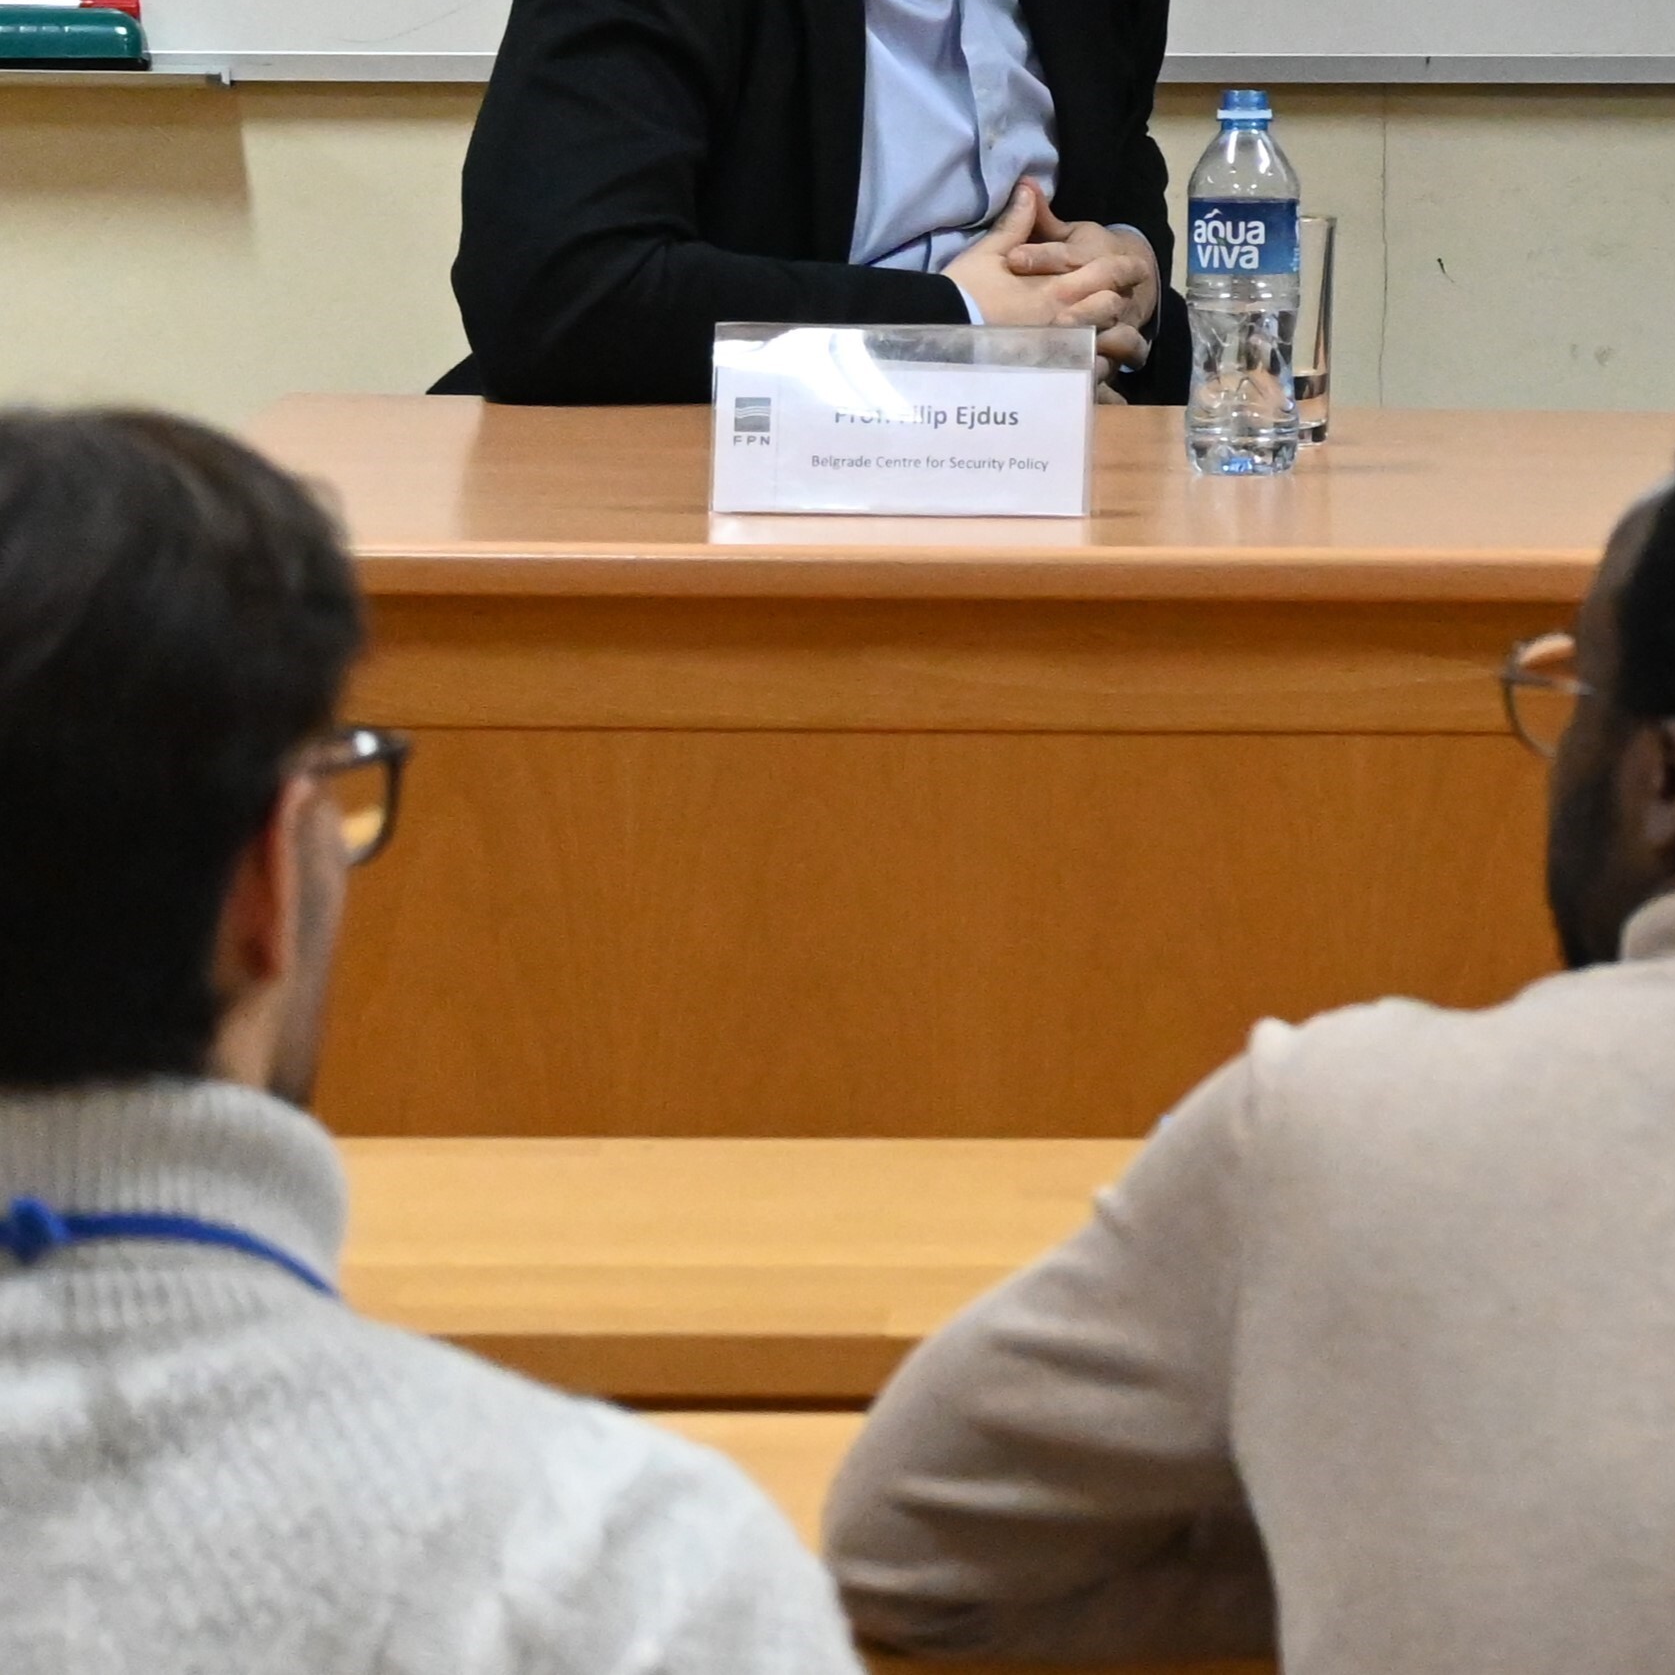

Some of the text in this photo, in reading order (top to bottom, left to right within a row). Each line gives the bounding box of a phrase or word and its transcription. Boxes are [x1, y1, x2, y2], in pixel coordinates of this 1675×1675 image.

[1193, 212, 1265, 245] aqua
[1197, 244, 1259, 269] viva
[956, 406, 1019, 429] Ejdus
[733, 435, 771, 446] FPN
[811, 455, 1049, 472] Belgrade Centre for Security Policy
